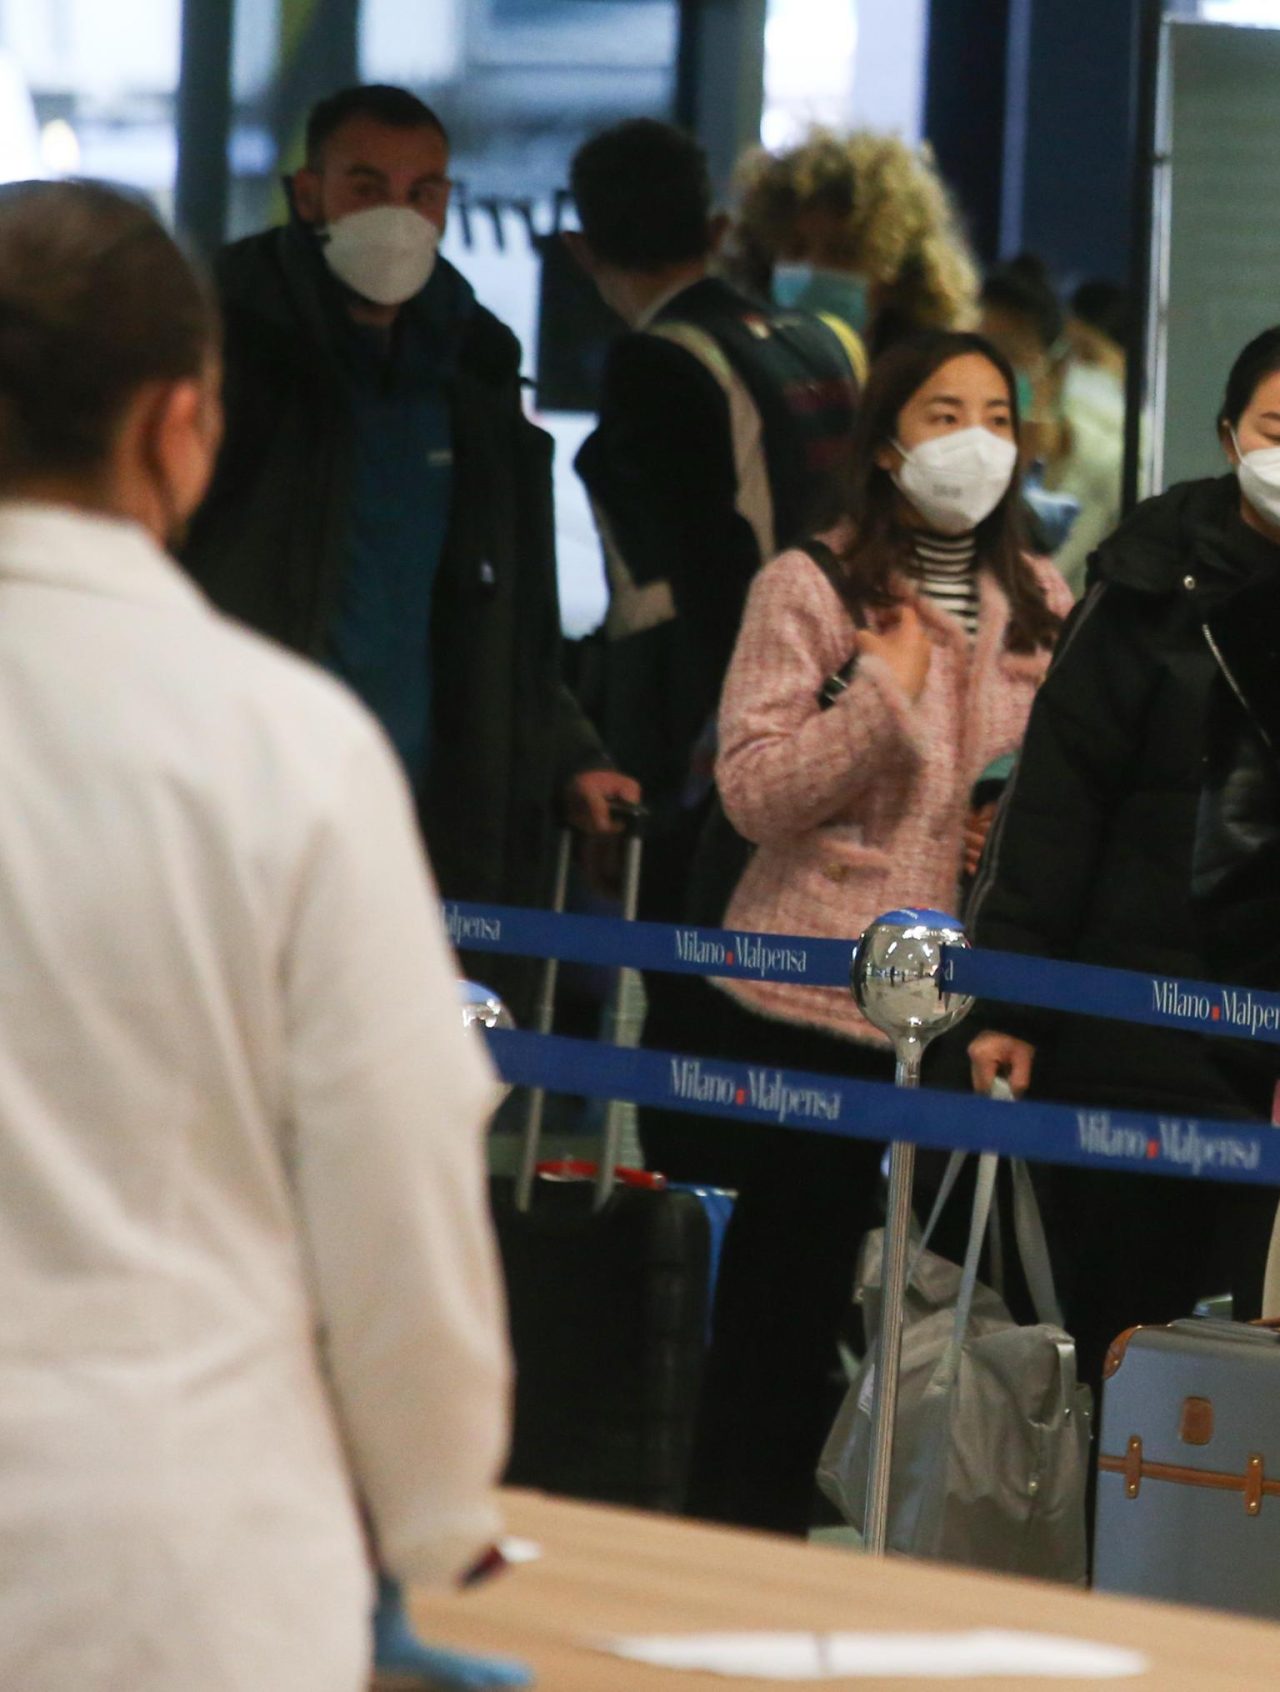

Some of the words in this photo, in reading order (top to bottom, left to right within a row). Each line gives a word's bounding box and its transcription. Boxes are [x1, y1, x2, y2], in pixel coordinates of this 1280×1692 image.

[676, 930, 725, 964] Milano
[735, 936, 807, 978] Malpensa
[1152, 980, 1210, 1020] Milano
[671, 1058, 735, 1104] Milano
[748, 1069, 841, 1123] Malpensa
